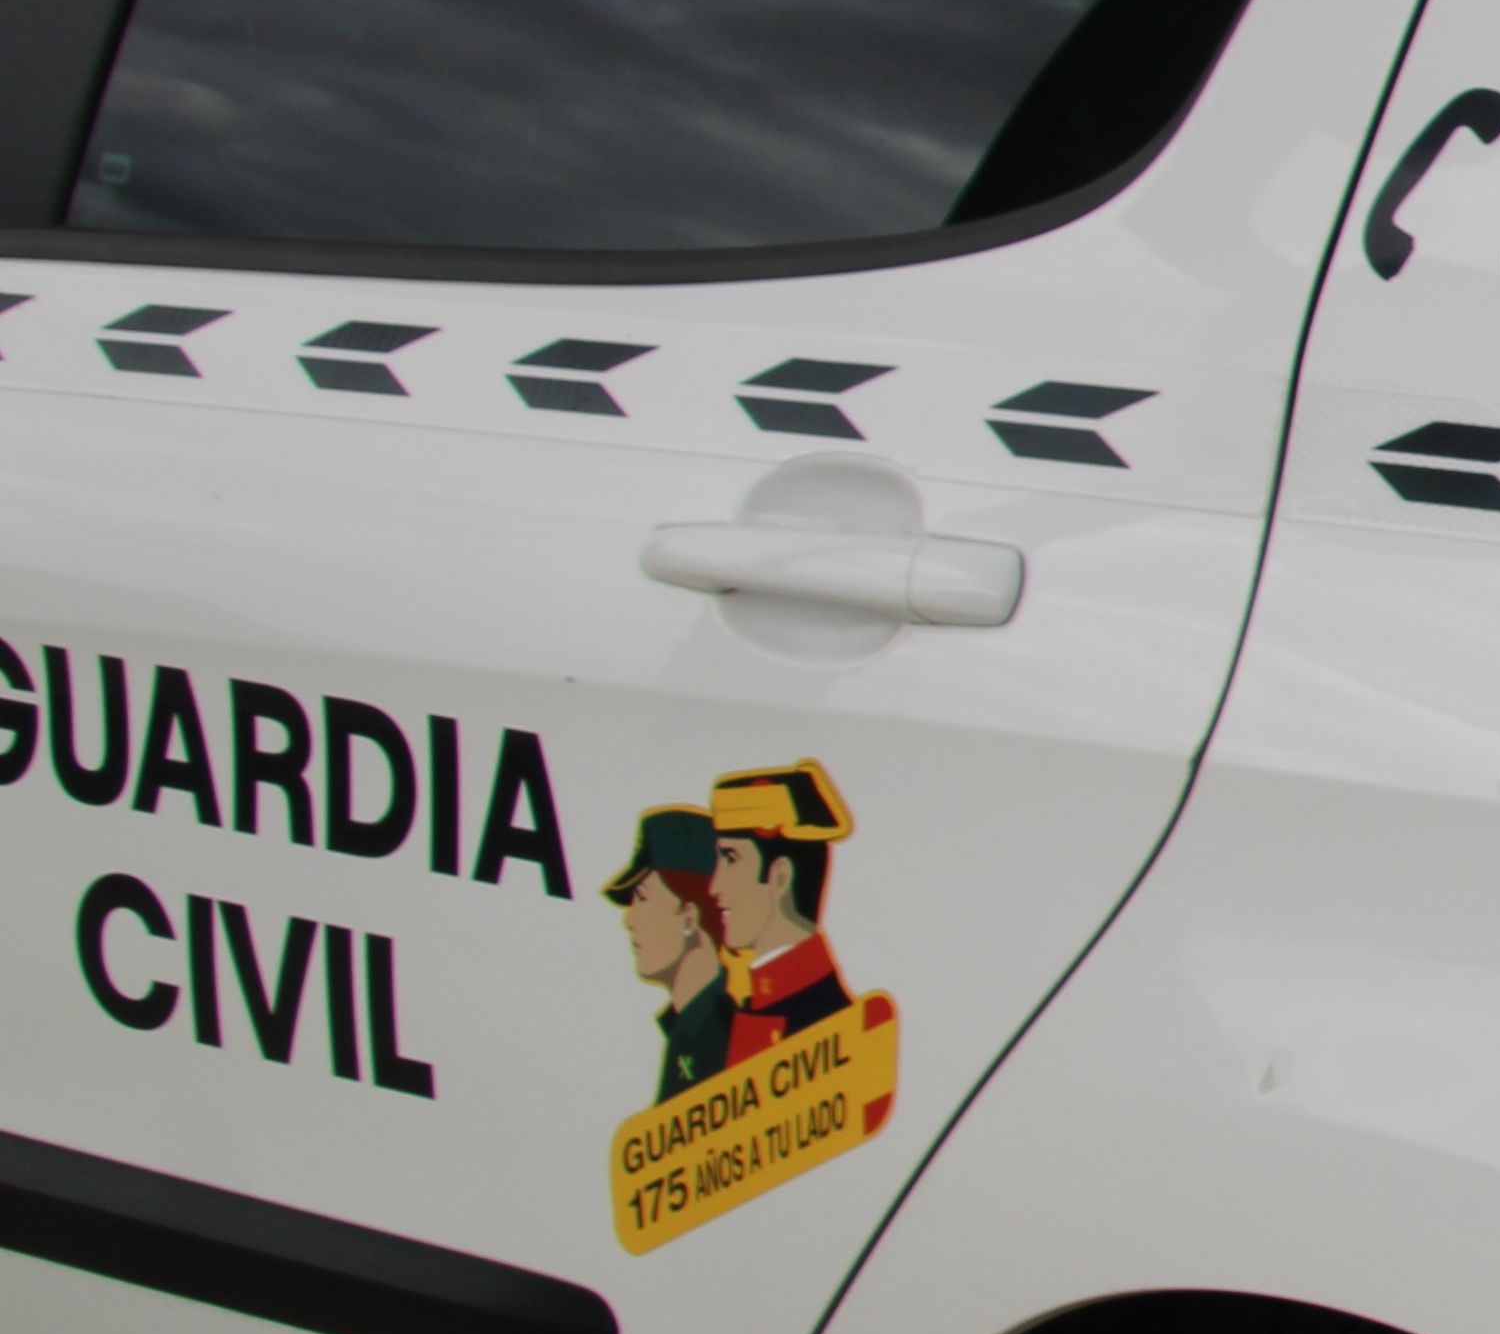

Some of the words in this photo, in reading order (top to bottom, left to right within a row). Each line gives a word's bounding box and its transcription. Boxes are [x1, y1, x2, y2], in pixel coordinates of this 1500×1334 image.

[74, 871, 436, 1100] CIVIL
[621, 1076, 761, 1174] GUARDIA
[770, 1032, 851, 1099] CIVIL
[628, 1166, 688, 1231] 175
[695, 1143, 745, 1202] AÑOS
[749, 1135, 763, 1175] A
[765, 1118, 791, 1165] TU
[797, 1091, 847, 1150] LADO
